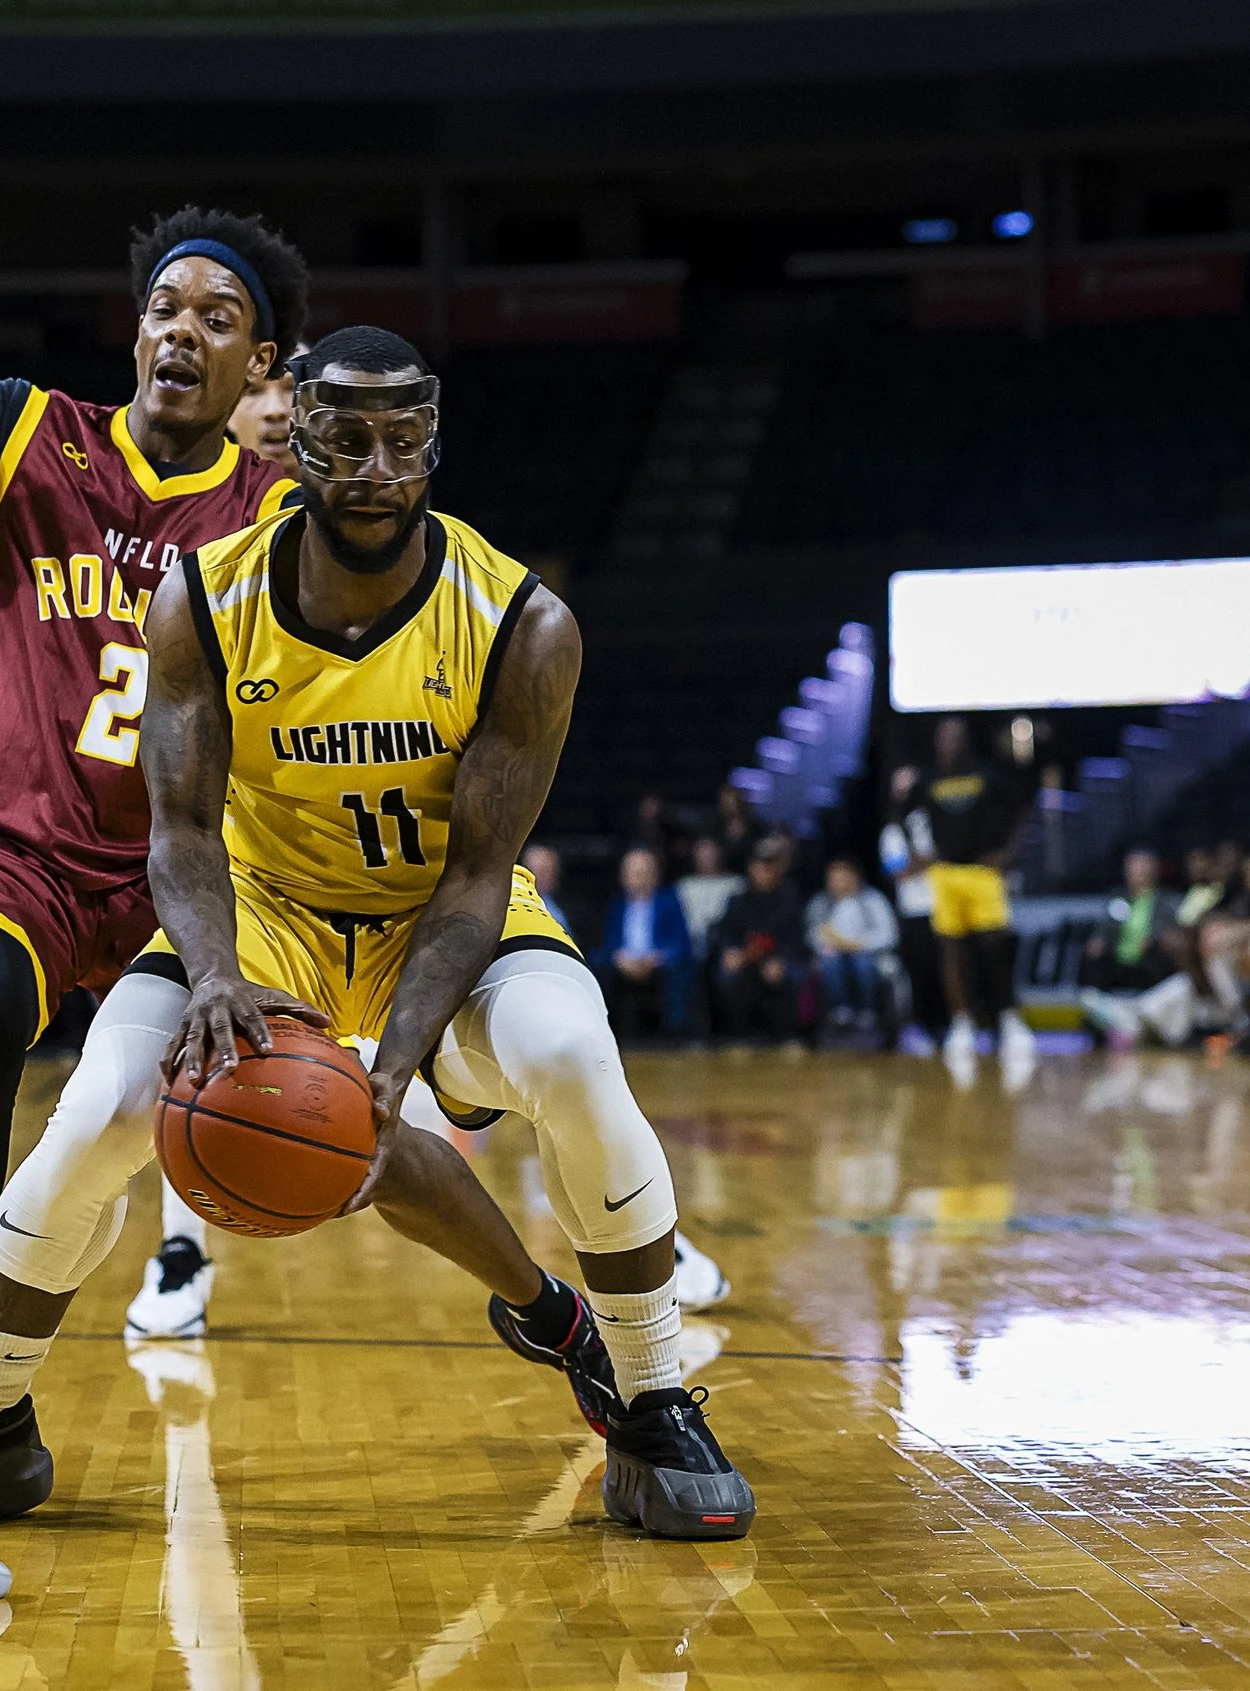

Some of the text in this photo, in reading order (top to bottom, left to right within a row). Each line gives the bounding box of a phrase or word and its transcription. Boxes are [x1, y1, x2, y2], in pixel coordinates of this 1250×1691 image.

[104, 528, 180, 572] NFLD
[75, 641, 149, 767] 2
[341, 787, 428, 869] 11
